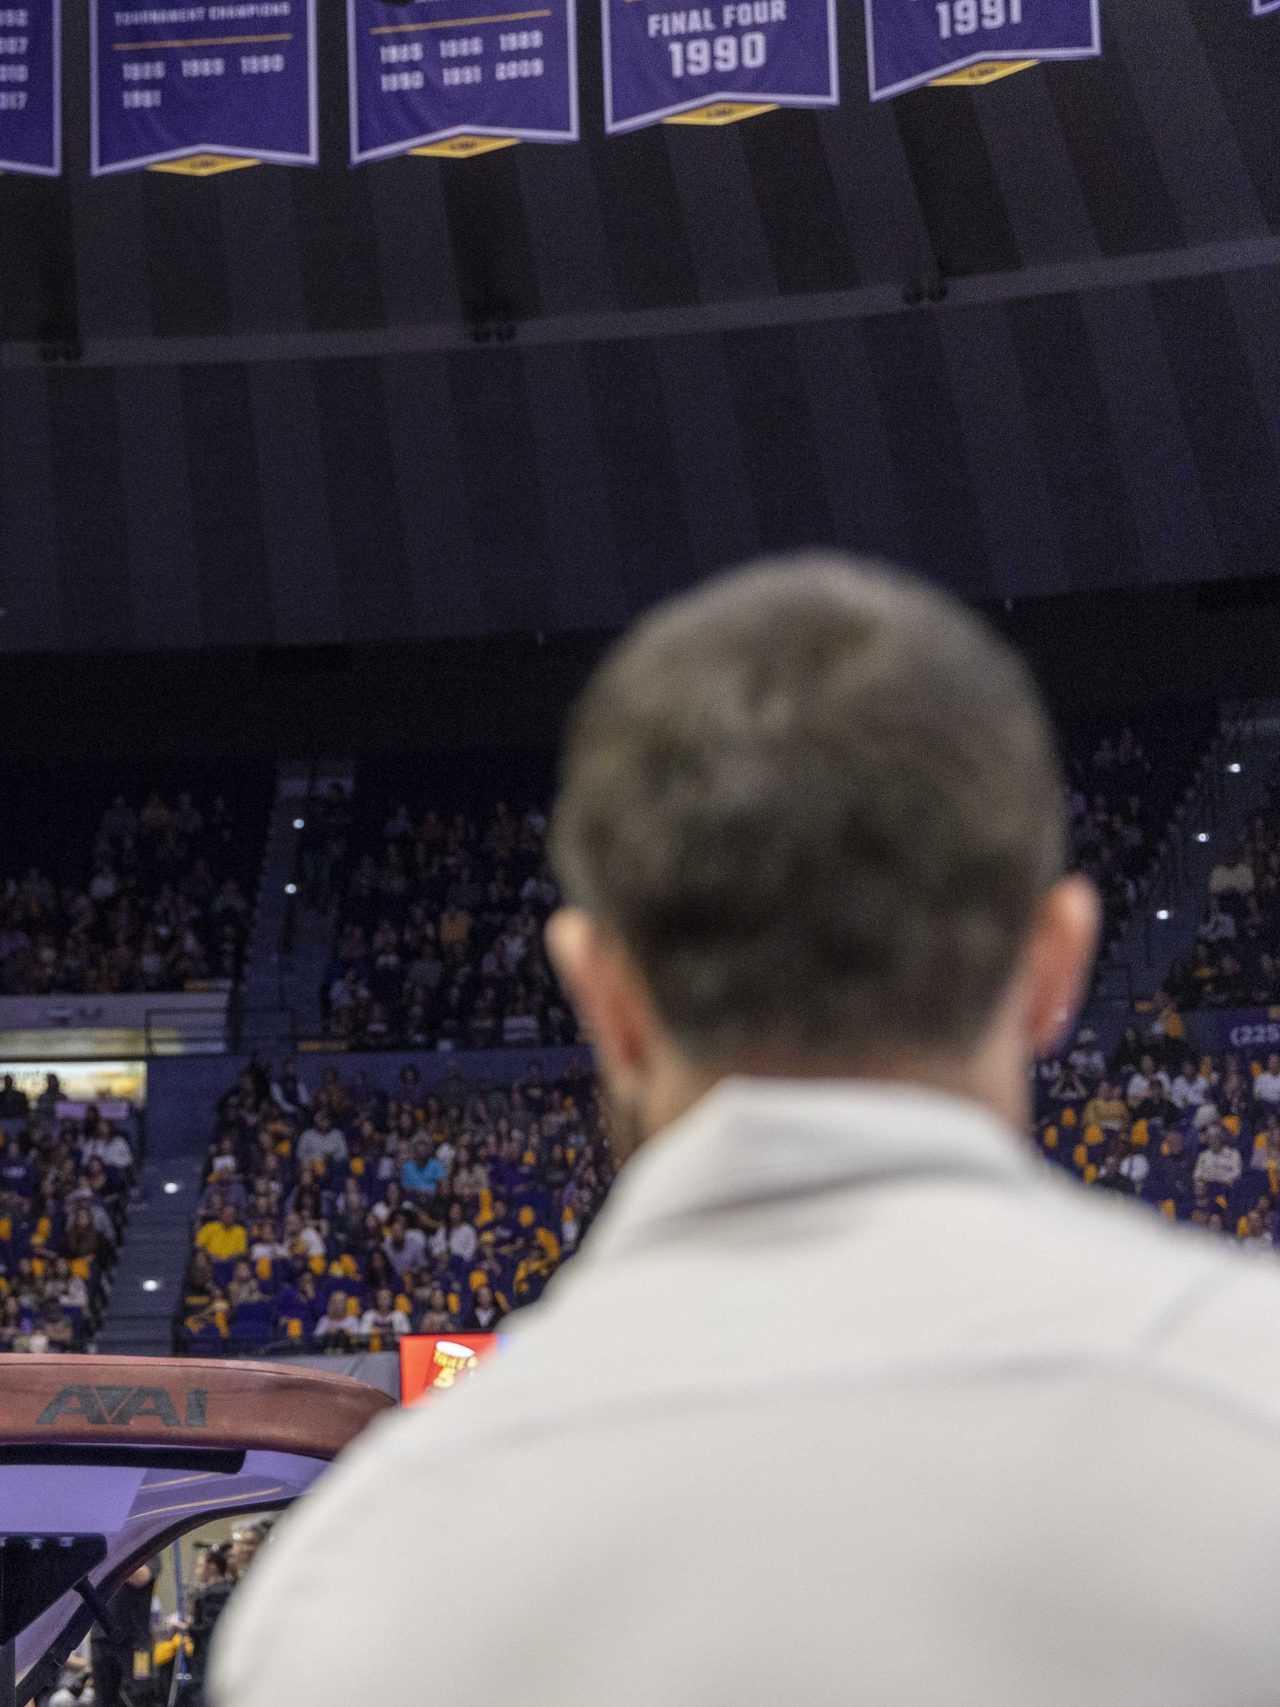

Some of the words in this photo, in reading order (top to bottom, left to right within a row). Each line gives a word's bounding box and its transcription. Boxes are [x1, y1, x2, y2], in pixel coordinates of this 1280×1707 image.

[647, 7, 716, 39] FINAL
[722, 0, 787, 29] FOUR
[935, 0, 1022, 39] 1991
[666, 30, 766, 78] 1990
